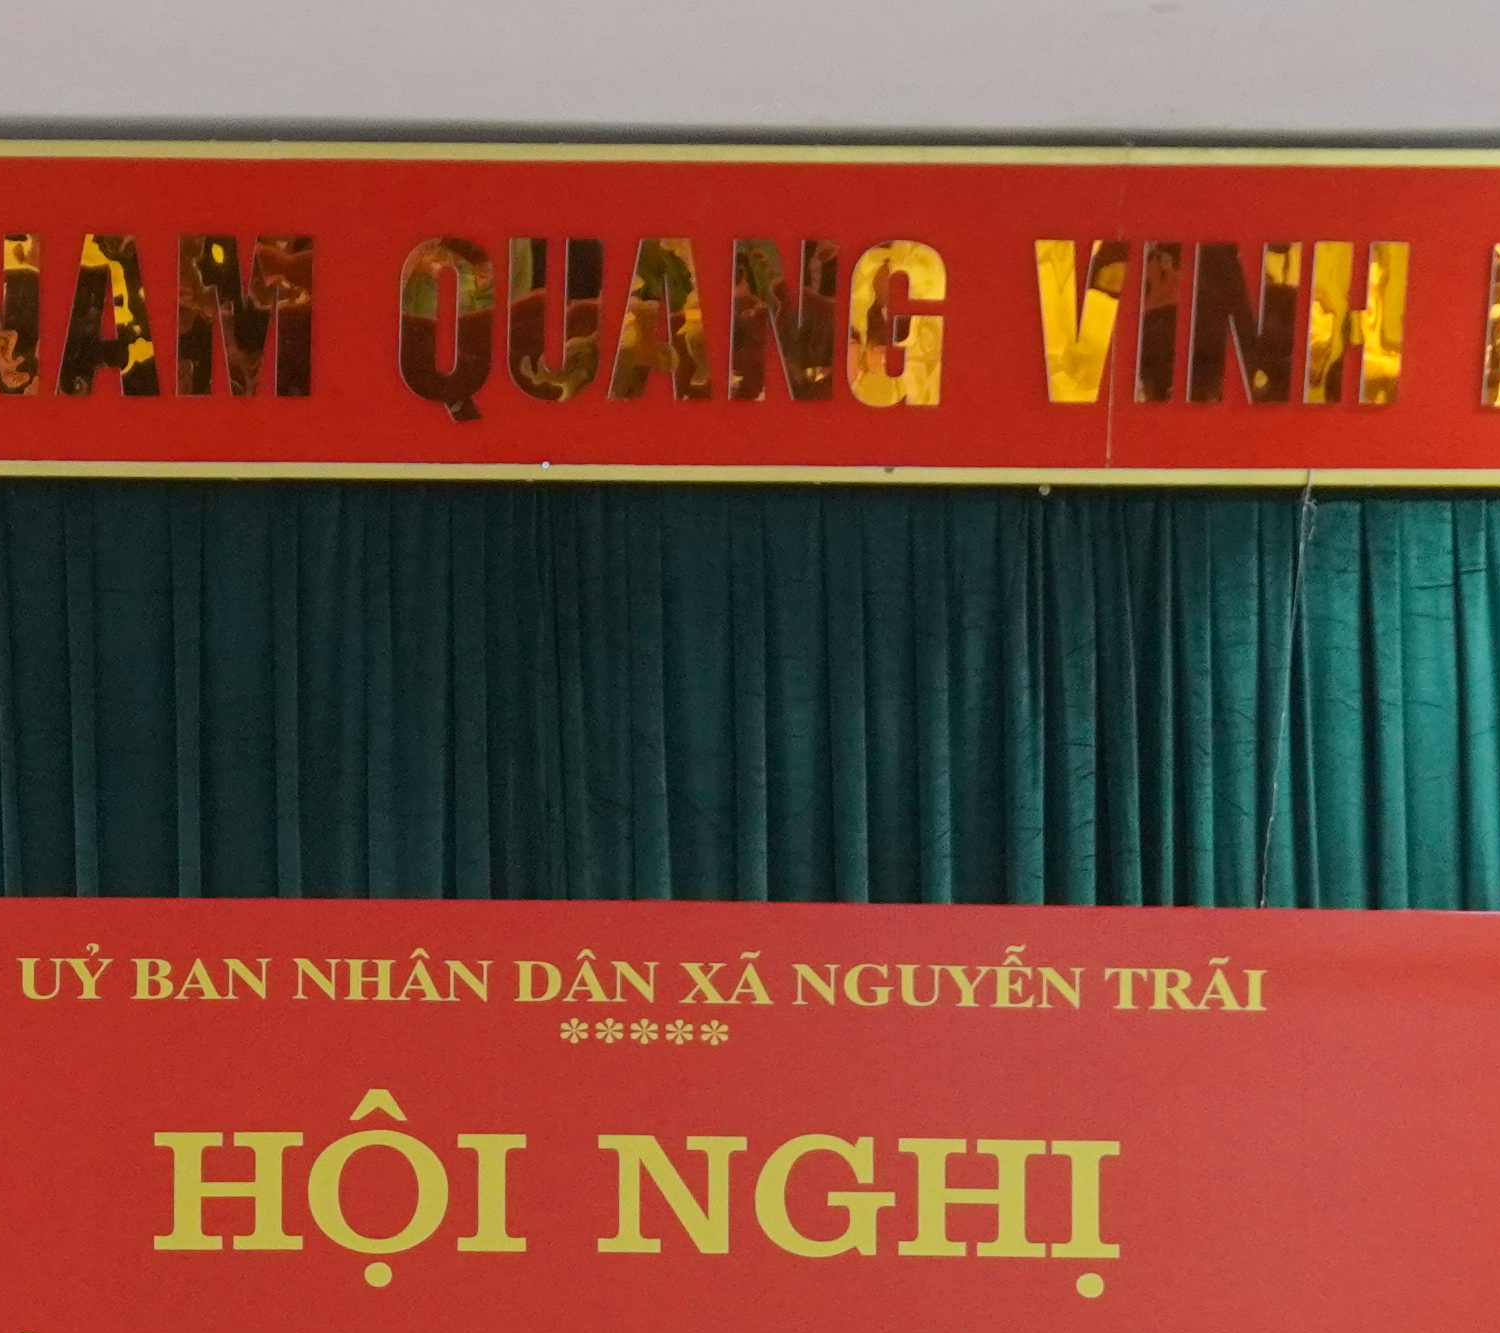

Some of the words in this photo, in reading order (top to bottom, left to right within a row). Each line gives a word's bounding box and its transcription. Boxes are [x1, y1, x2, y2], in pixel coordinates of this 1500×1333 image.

[399, 236, 947, 422] QUANG
[1034, 239, 1411, 405] VINH
[16, 943, 114, 1000] UỶ
[131, 957, 269, 1001] BAN
[292, 948, 492, 1002] NHÂN
[513, 949, 661, 1003] DÂN
[679, 950, 775, 1005] XÃ
[792, 944, 1086, 1009] NGUYỄN
[1104, 956, 1268, 1012] TRÃI
[152, 1088, 527, 1288] HỘI
[597, 1133, 1120, 1298] NGHỊ
